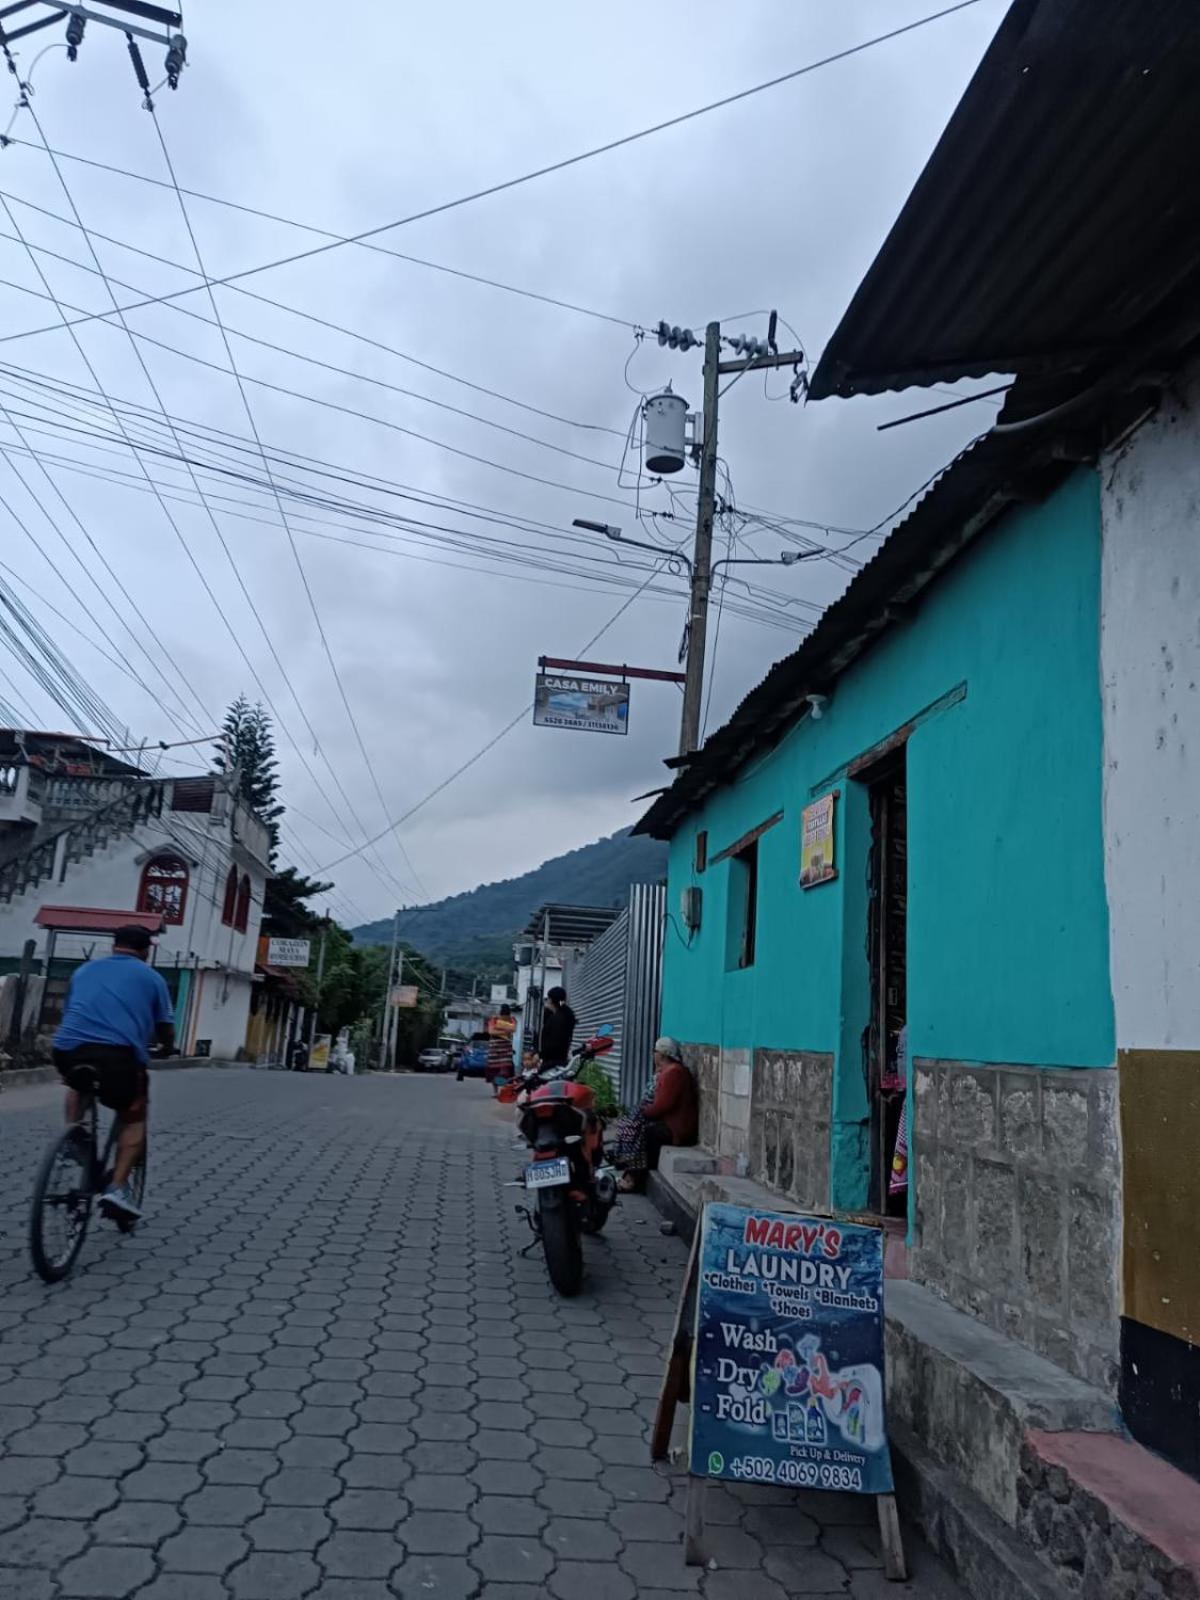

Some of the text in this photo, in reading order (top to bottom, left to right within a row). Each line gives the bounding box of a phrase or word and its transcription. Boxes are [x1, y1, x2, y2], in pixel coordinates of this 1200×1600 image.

[545, 678, 618, 695] CASA EMILY
[745, 1217, 841, 1257] MARY'S
[727, 1249, 852, 1290] LAUNDRY
[720, 1323, 778, 1353] Wash
[717, 1358, 760, 1390] Dry
[716, 1394, 766, 1424] Fold
[790, 1446, 866, 1465] Pick Up & Delivery
[730, 1456, 862, 1489] +502 4069 9834
